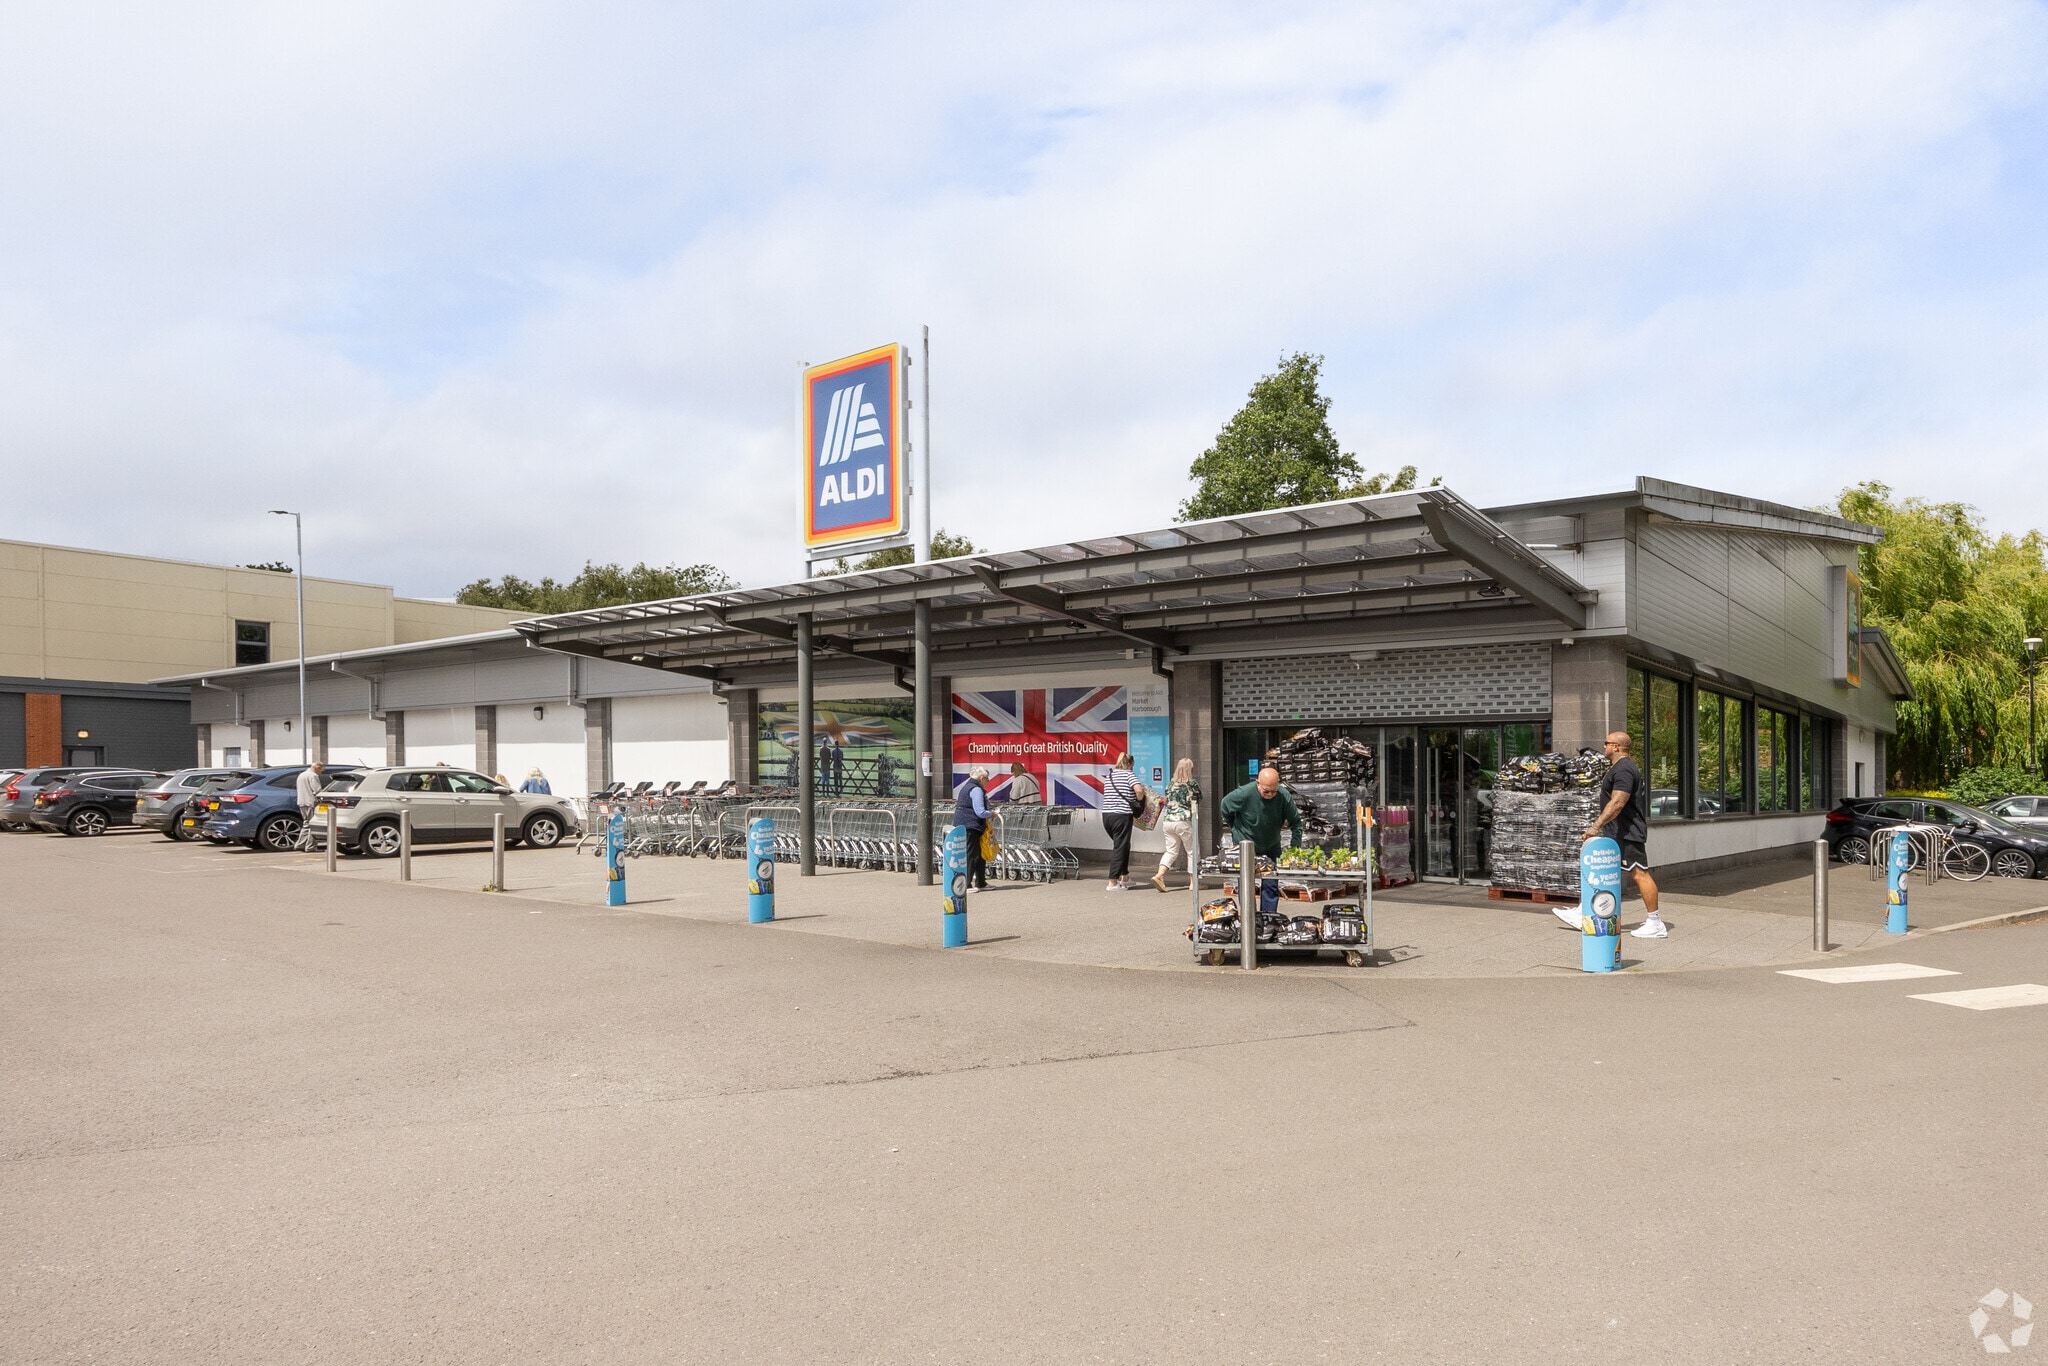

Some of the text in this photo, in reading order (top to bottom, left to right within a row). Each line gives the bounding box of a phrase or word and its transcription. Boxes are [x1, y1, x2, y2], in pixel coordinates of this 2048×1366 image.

[820, 464, 885, 506] ALDI
[1132, 697, 1149, 705] Market
[1132, 704, 1162, 714] Harborough
[968, 741, 1108, 756] Championing Great British Quality
[1587, 871, 1600, 886] 4
